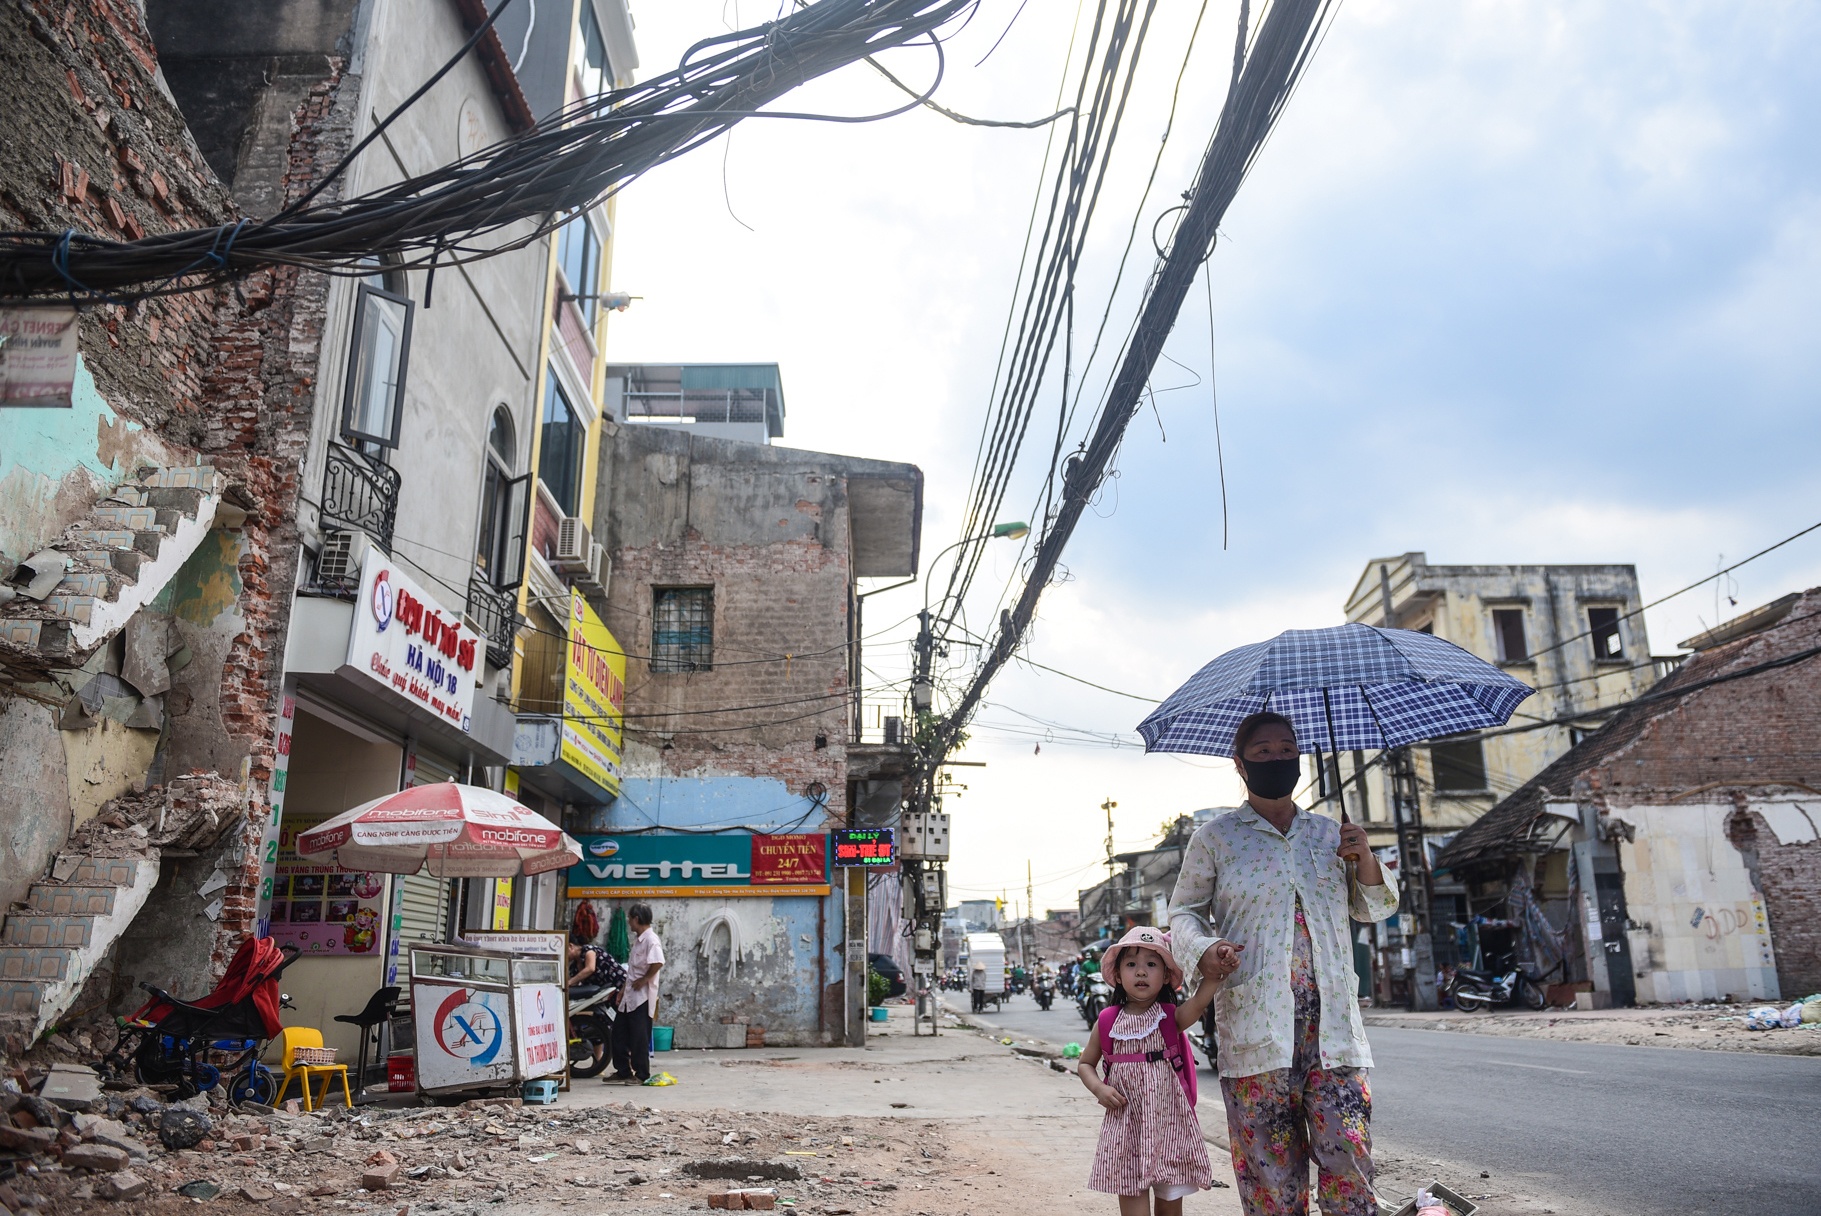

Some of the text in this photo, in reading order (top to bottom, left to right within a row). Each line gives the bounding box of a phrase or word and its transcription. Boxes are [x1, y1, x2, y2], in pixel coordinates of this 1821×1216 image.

[423, 610, 442, 646] LÝ
[426, 657, 446, 689] NỘI
[446, 672, 458, 696] 18
[392, 672, 409, 693] quý
[409, 676, 430, 702] khách
[431, 696, 446, 715] may
[272, 804, 279, 827] 1
[368, 808, 460, 816] mobifone
[309, 830, 344, 849] mobifone
[482, 829, 547, 843] mobifone
[265, 840, 278, 863] 2
[586, 860, 751, 879] VIETTEL
[777, 858, 800, 868] 24/7
[262, 878, 273, 900] 3
